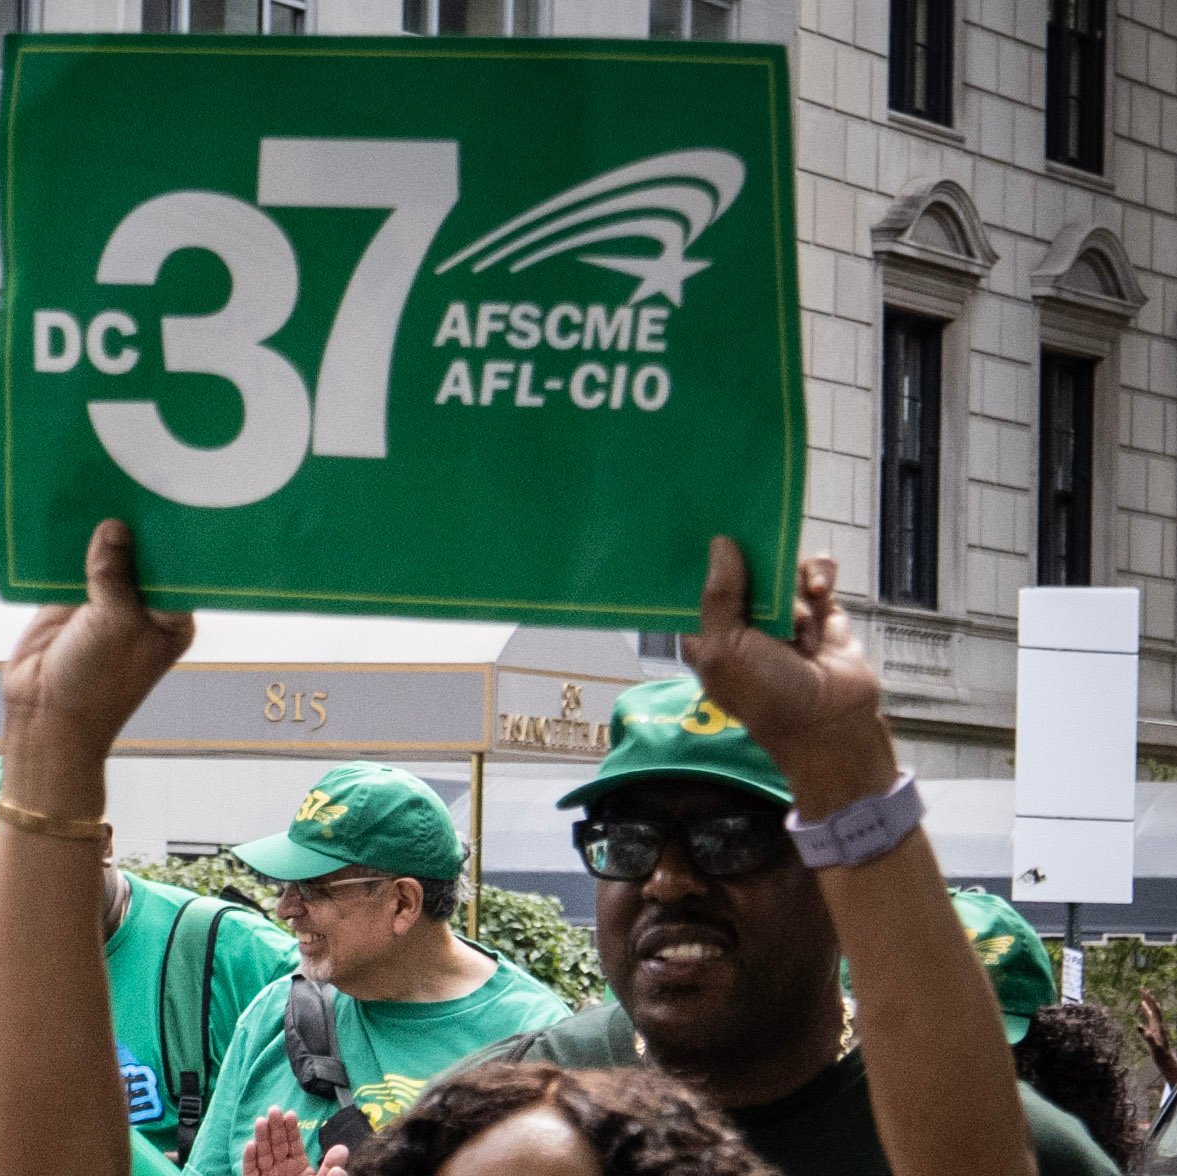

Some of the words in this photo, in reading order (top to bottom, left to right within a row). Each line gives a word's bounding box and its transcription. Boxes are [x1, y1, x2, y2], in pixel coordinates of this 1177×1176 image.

[33, 307, 140, 375] DC
[87, 137, 460, 509] 37
[432, 301, 670, 352] AFSCME
[434, 359, 671, 411] AFL-CIO
[264, 681, 329, 731] 815
